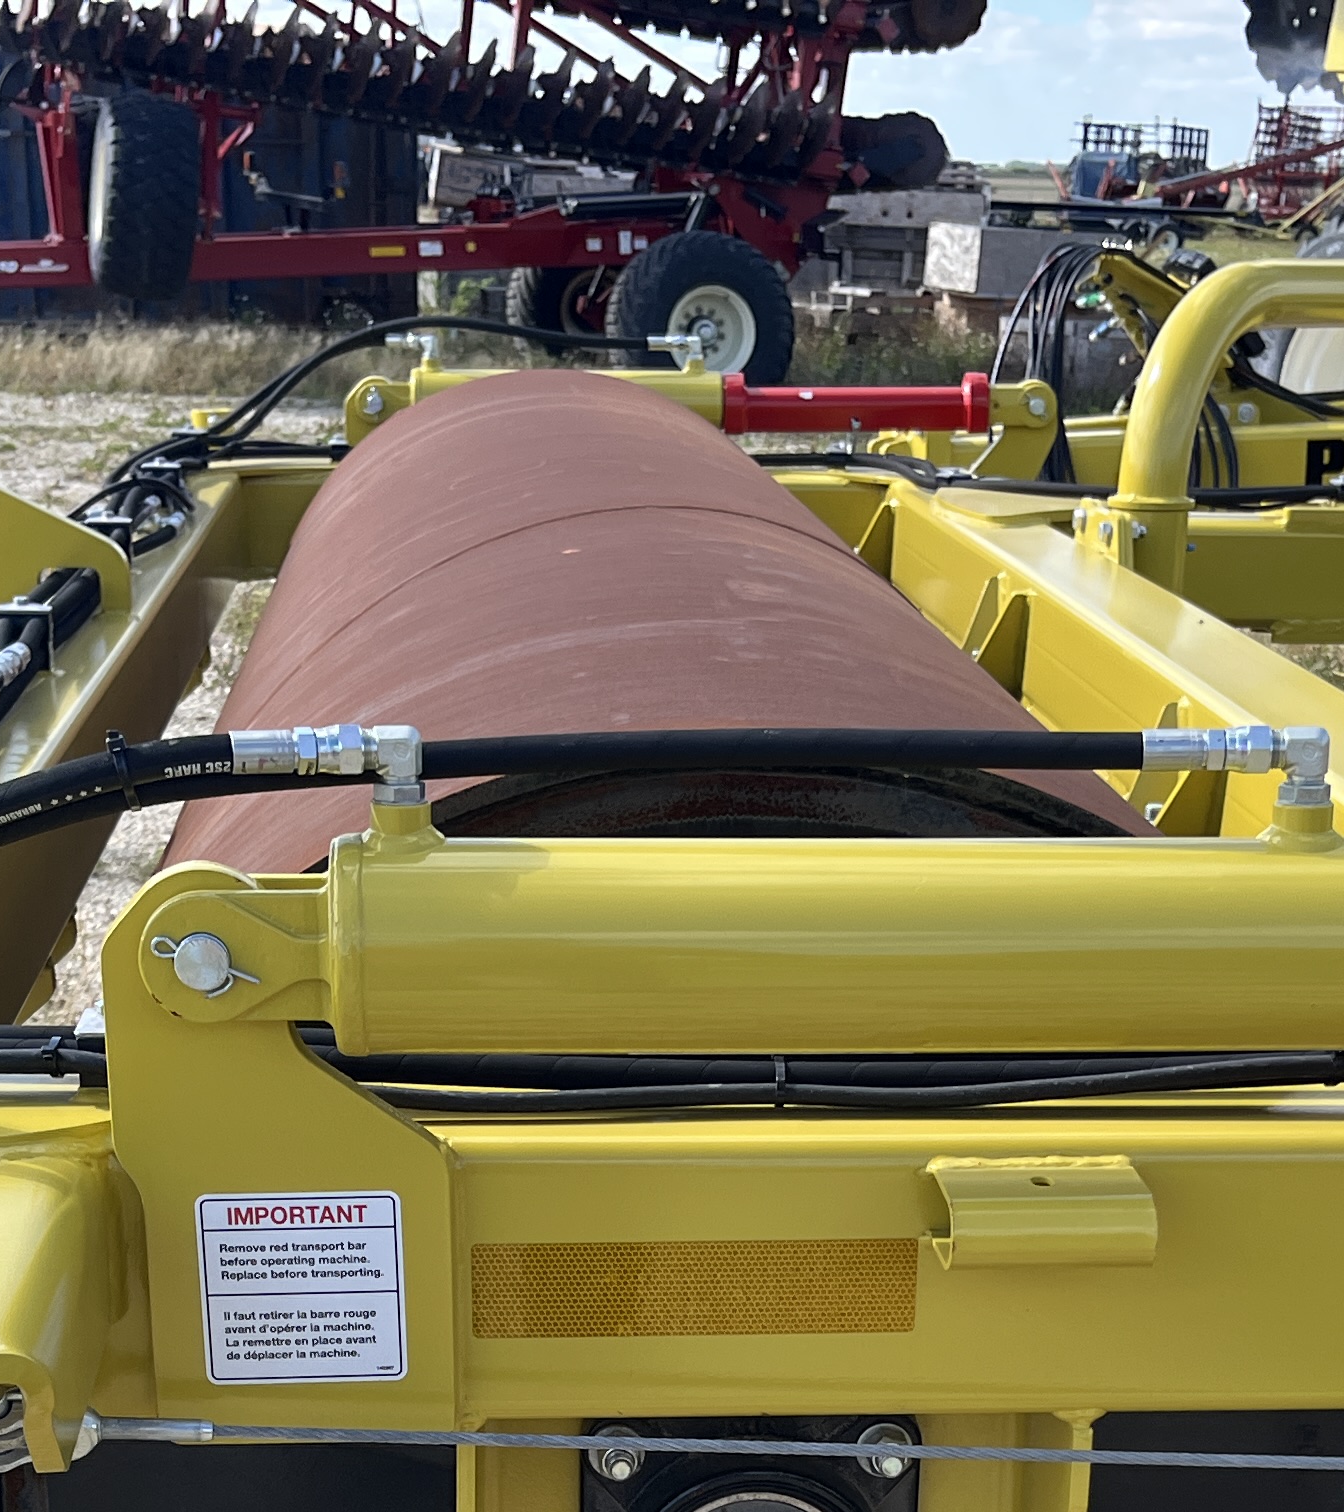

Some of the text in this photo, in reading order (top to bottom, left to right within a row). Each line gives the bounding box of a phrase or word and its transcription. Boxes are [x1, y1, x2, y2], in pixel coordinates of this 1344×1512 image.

[205, 761, 231, 773] 2SC
[227, 1204, 367, 1225] IMPORTANT
[219, 1241, 367, 1253] Remove red transport bar
[220, 1254, 370, 1268] before operating machine.
[221, 1267, 385, 1282] Replace before transporting.
[223, 1309, 377, 1321] Il faut retirer la barre rouge
[224, 1321, 375, 1335] avant d'opérer la machine.
[225, 1335, 377, 1347] La remettre en place avant
[226, 1348, 361, 1362] de déplacer la machine.
